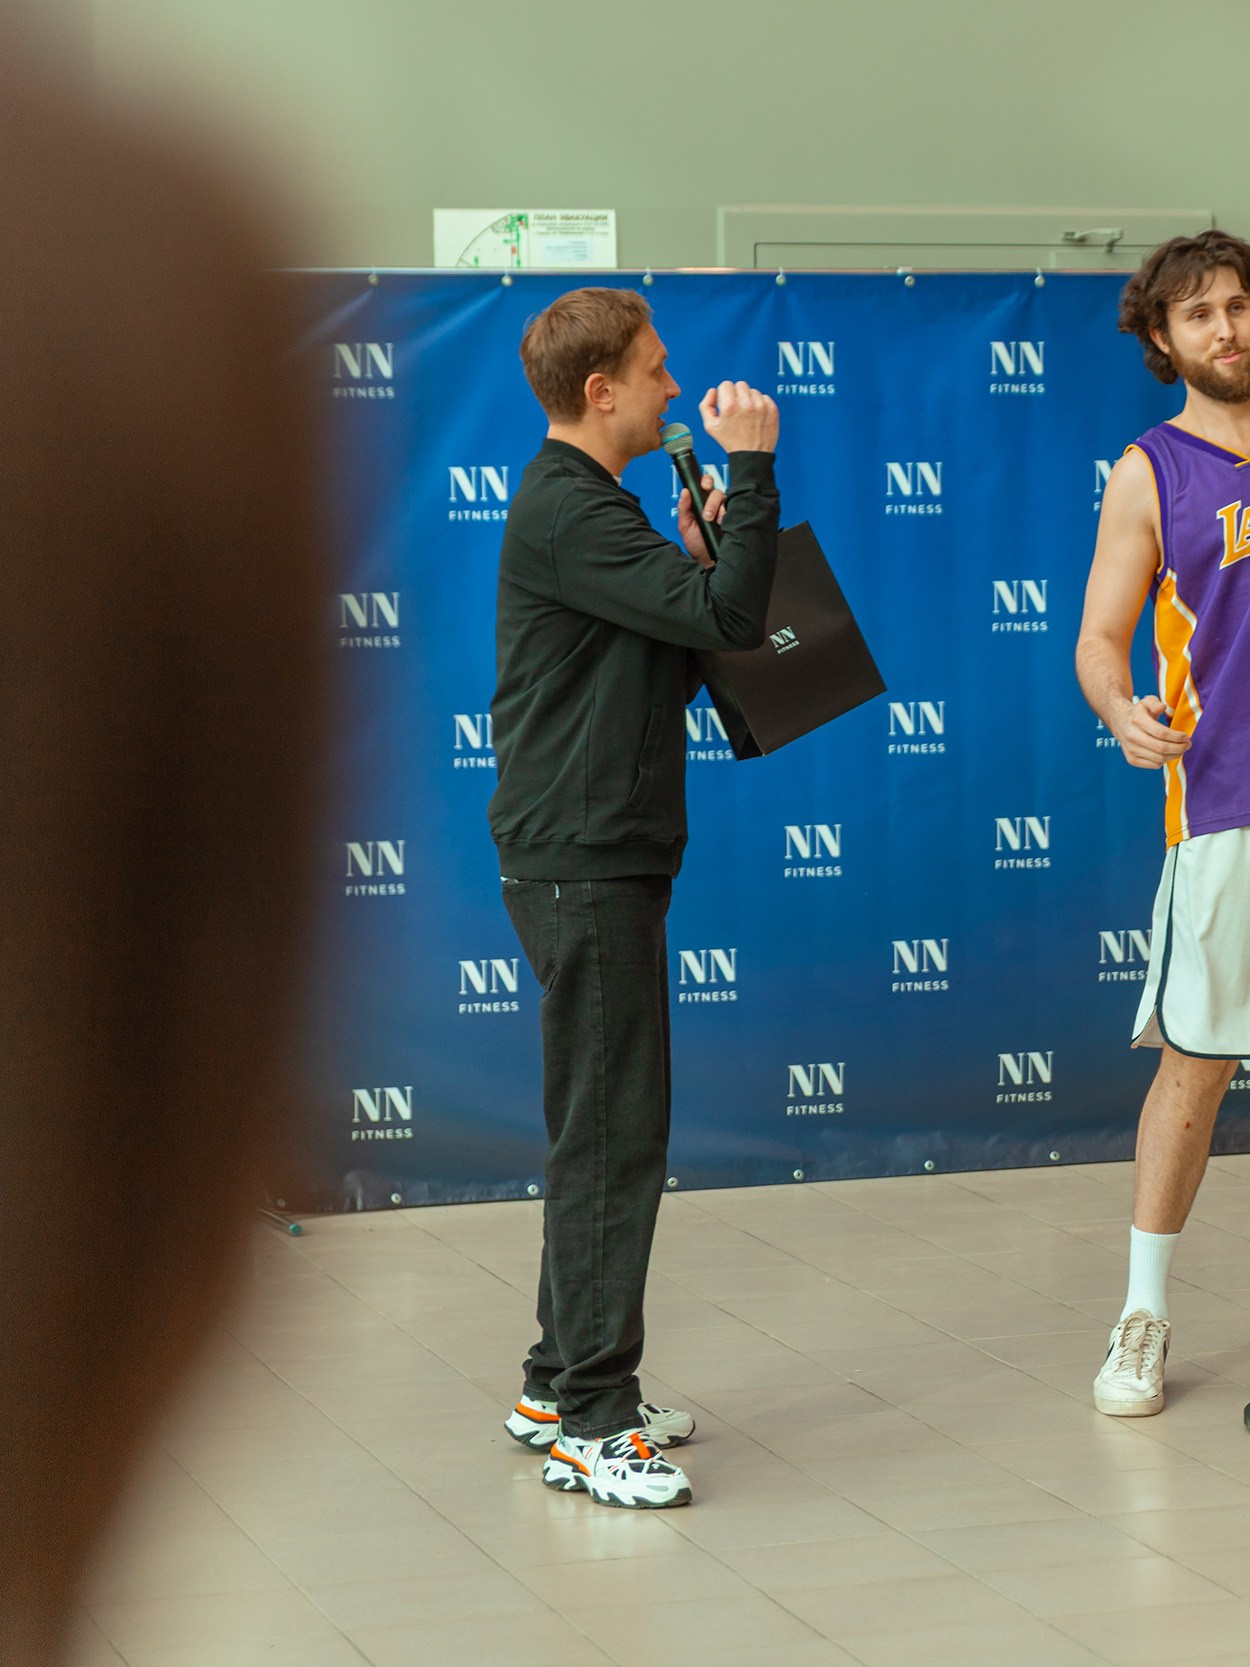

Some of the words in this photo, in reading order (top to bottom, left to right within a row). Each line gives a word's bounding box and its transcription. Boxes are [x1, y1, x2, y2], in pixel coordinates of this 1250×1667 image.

[333, 343, 394, 380] NN
[777, 342, 835, 375] NN
[990, 341, 1044, 376] NN
[332, 387, 395, 399] FITNESS
[776, 384, 835, 395] FITNESS
[990, 382, 1045, 393] FITNESS
[448, 466, 508, 502] NN
[886, 462, 942, 497] NN
[449, 509, 508, 521] FITNESS
[886, 504, 943, 515] FITNESS
[992, 580, 1047, 614] NN
[339, 592, 399, 628] NN
[992, 622, 1047, 632] FITNESS
[340, 636, 400, 648] FITNESS
[769, 625, 796, 648] NN
[888, 701, 945, 736] NN
[686, 750, 734, 761] TNESS
[888, 743, 945, 755] FITNESS
[453, 757, 497, 769] FITNE
[995, 816, 1050, 851] NN
[784, 824, 842, 860] NN
[345, 840, 405, 877] NN
[995, 857, 1050, 869] FITNESS
[784, 866, 842, 878] FITNESS
[346, 884, 406, 896] FITNESS
[1098, 929, 1152, 963] NN
[891, 939, 949, 975] NN
[679, 949, 737, 985] NN
[458, 958, 519, 995] NN
[1098, 970, 1149, 982] FITNES
[892, 980, 949, 992] FITNESS
[679, 991, 737, 1003] FITNESS
[459, 1001, 519, 1013] FITNESS
[998, 1051, 1054, 1086] NN
[788, 1062, 845, 1098] NN
[996, 1091, 1052, 1104] FITNESS
[352, 1086, 413, 1123] NN
[787, 1103, 845, 1116] FITNESS
[351, 1128, 413, 1141] FITNESS
